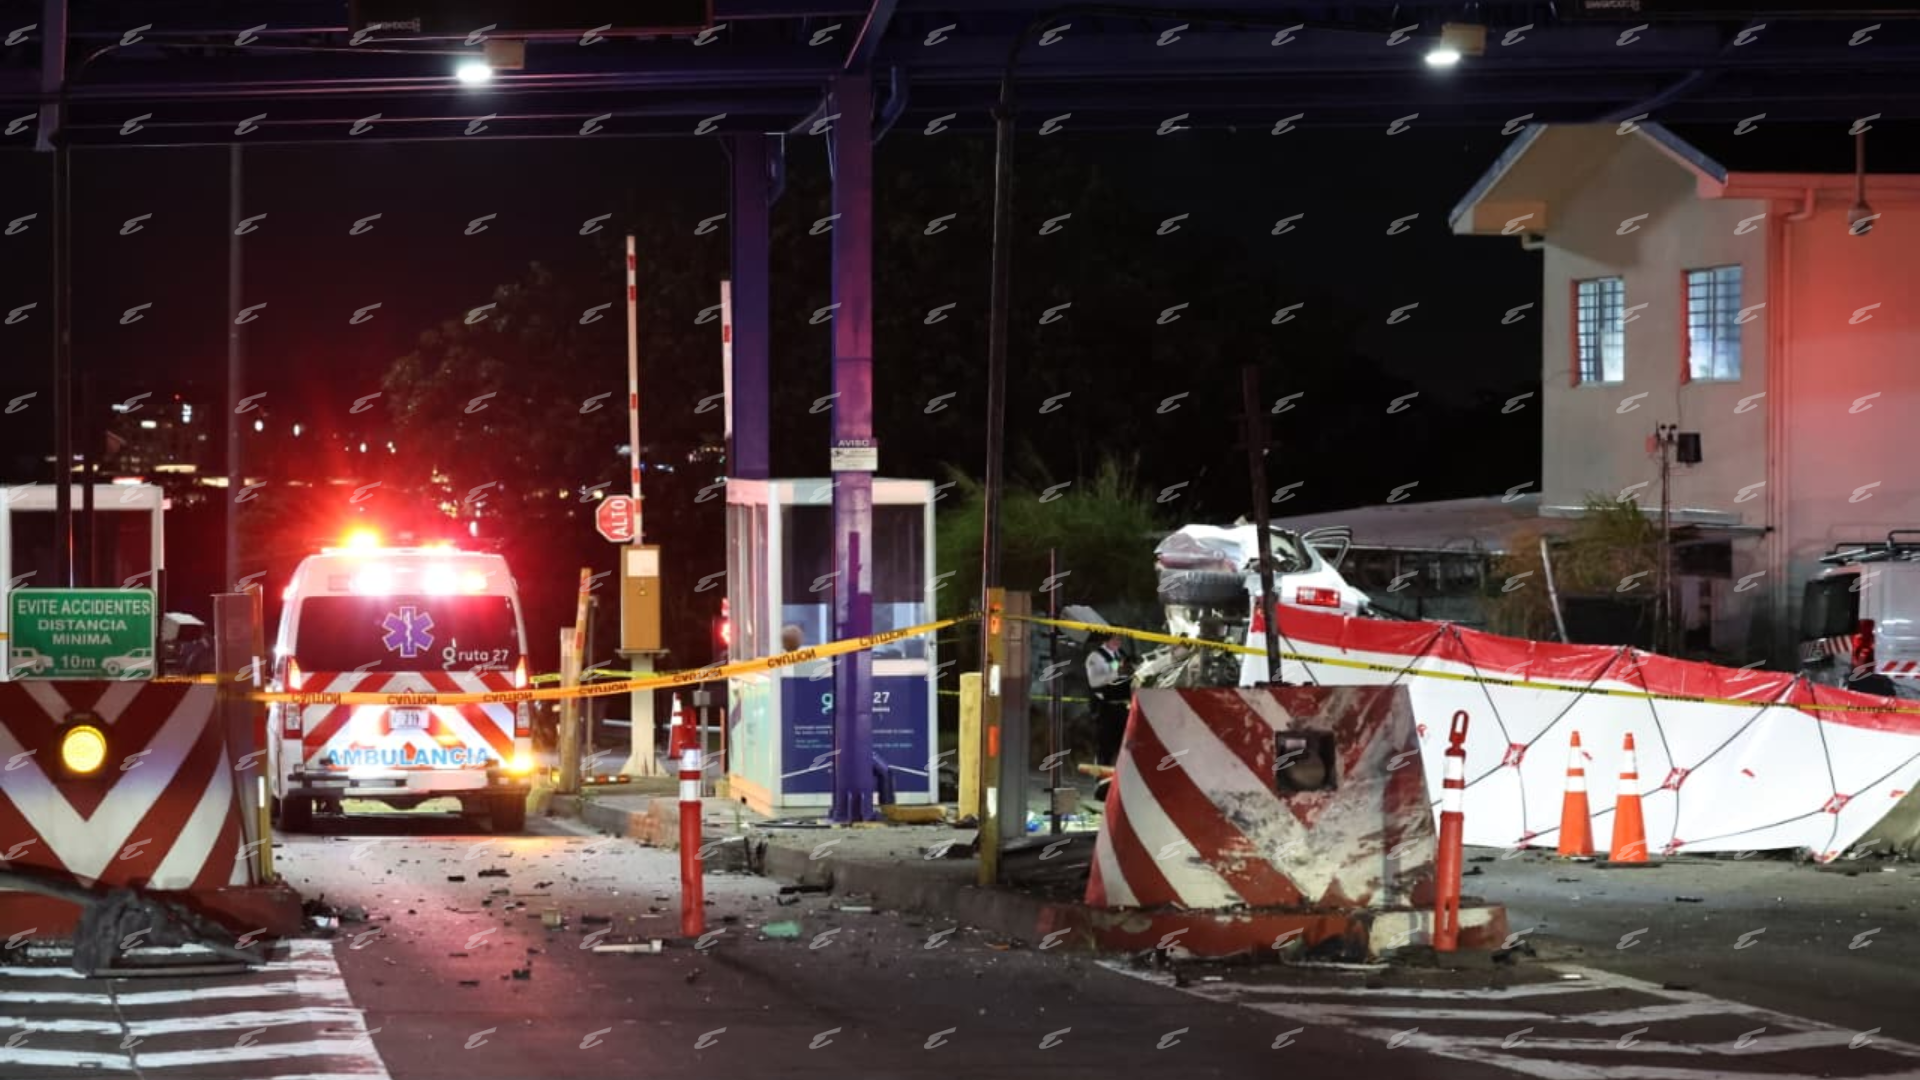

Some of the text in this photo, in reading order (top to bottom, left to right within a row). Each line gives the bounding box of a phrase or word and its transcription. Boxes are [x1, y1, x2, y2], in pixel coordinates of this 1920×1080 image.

[838, 439, 870, 447] AVISO
[611, 500, 628, 537] ALTO
[18, 599, 150, 615] EVITE ACCIDENTES
[38, 619, 127, 631] DISTANCIA
[52, 634, 112, 645] MINIMA
[458, 649, 489, 661] ruta
[492, 649, 509, 661] 27
[61, 655, 96, 668] 10m
[872, 692, 890, 703] 27
[328, 747, 488, 765] AMBULANCIA
